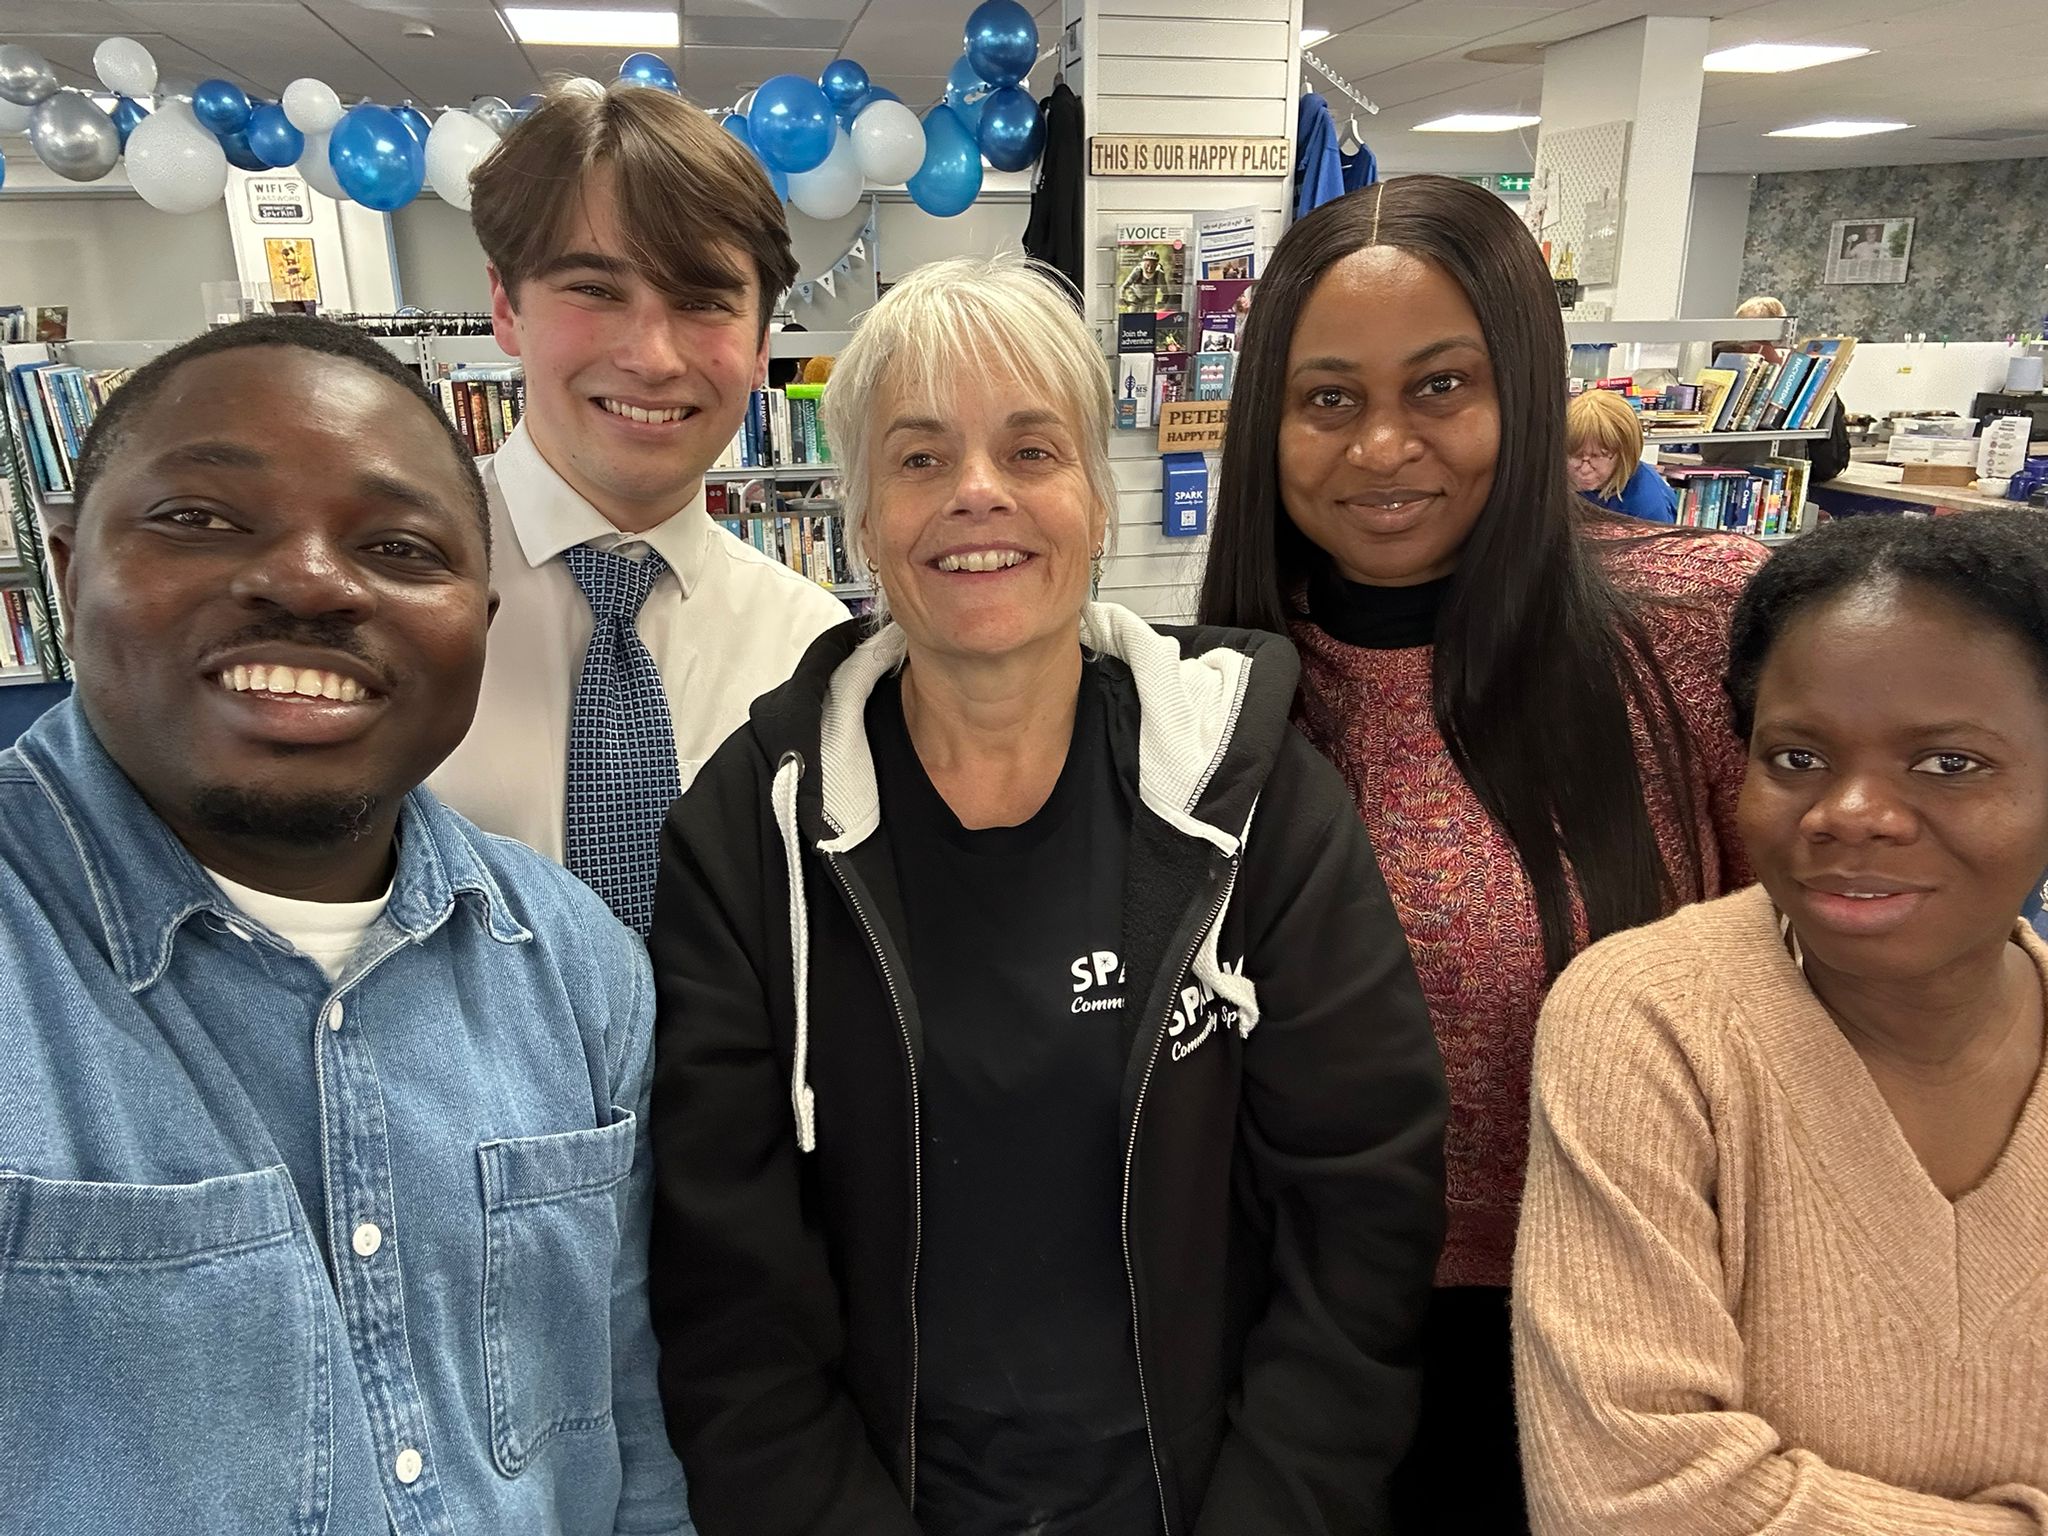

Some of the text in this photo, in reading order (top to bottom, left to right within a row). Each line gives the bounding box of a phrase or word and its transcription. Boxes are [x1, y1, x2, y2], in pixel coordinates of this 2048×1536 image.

[1095, 144, 1287, 170] THIS IS OUR HAPPY PLACE
[254, 184, 282, 193] WIFI
[1126, 227, 1167, 239] VOICE
[1121, 329, 1148, 338] Join the
[1121, 338, 1154, 346] adventure
[1778, 357, 1803, 404] ENCYCLOPEDIA
[1200, 389, 1223, 401] LOOK
[1167, 430, 1224, 442] HAPPY PL
[1175, 491, 1203, 500] SPARK
[1741, 490, 1750, 509] China
[1071, 996, 1125, 1013] Comm
